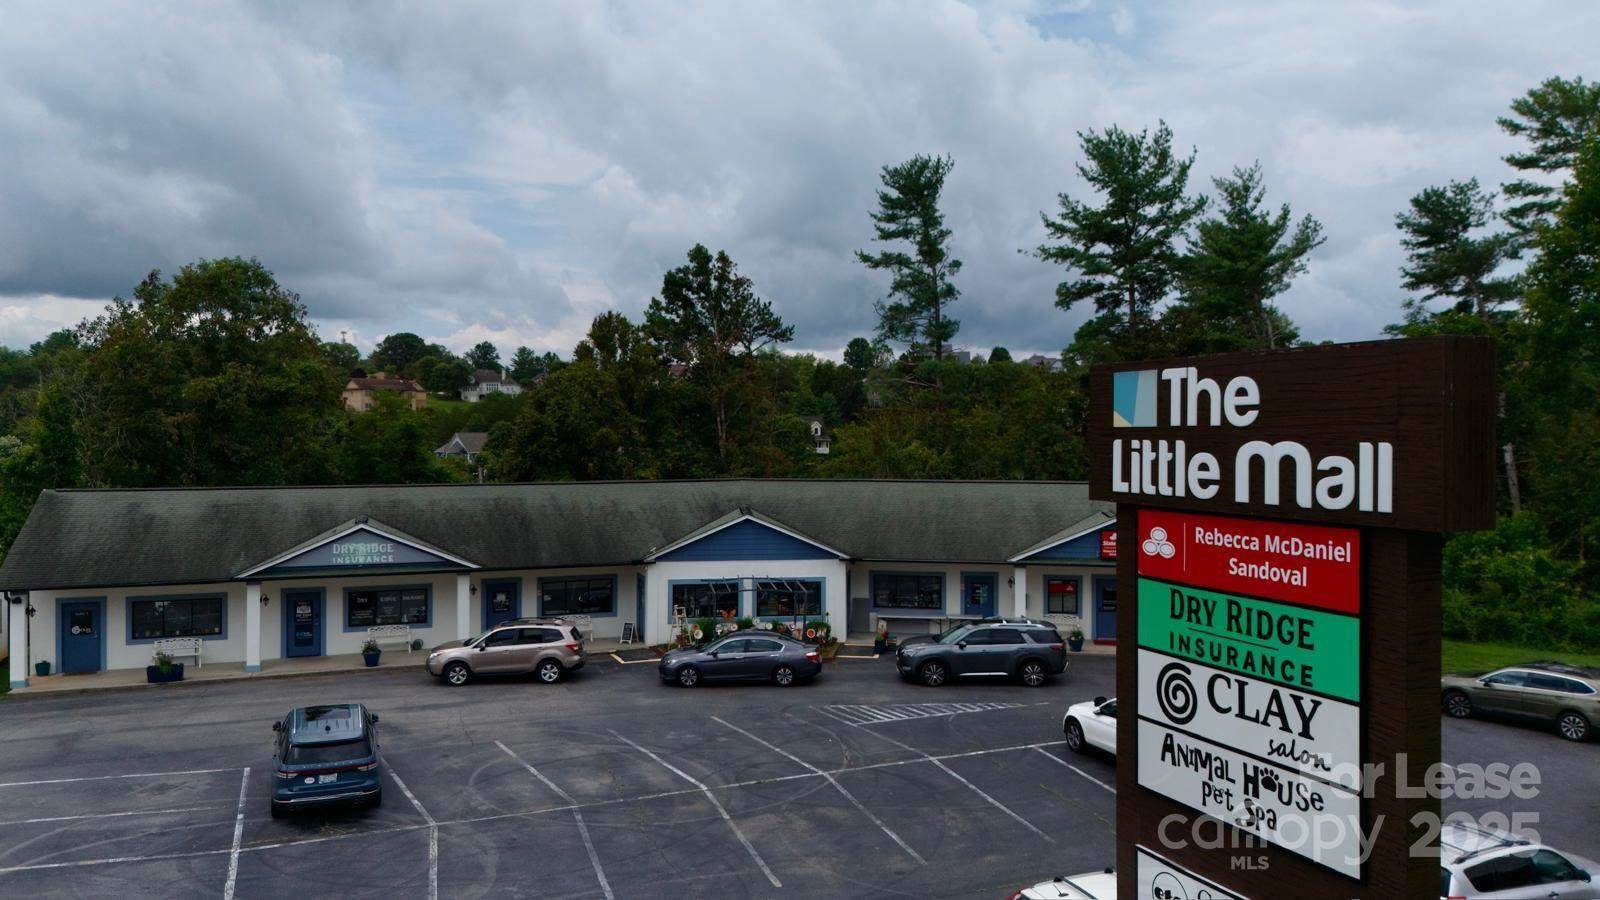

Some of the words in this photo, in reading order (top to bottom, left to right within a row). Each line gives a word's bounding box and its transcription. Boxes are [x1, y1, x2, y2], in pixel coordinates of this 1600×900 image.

[1161, 366, 1260, 428] The
[1112, 438, 1221, 500] Little
[1235, 440, 1393, 513] Mall
[333, 543, 354, 554] DRY
[359, 542, 394, 553] RIDGE
[333, 555, 394, 564] INSURANCE
[1195, 527, 1260, 551] Rebecca
[1265, 534, 1351, 563] McDaniel
[1229, 557, 1307, 587] Sandoval
[1169, 588, 1217, 627] DRY
[1226, 598, 1315, 651] RIDGE
[1170, 631, 1314, 688] INSURANCE
[1207, 673, 1322, 741] CLAY
[1267, 738, 1331, 771] salon
